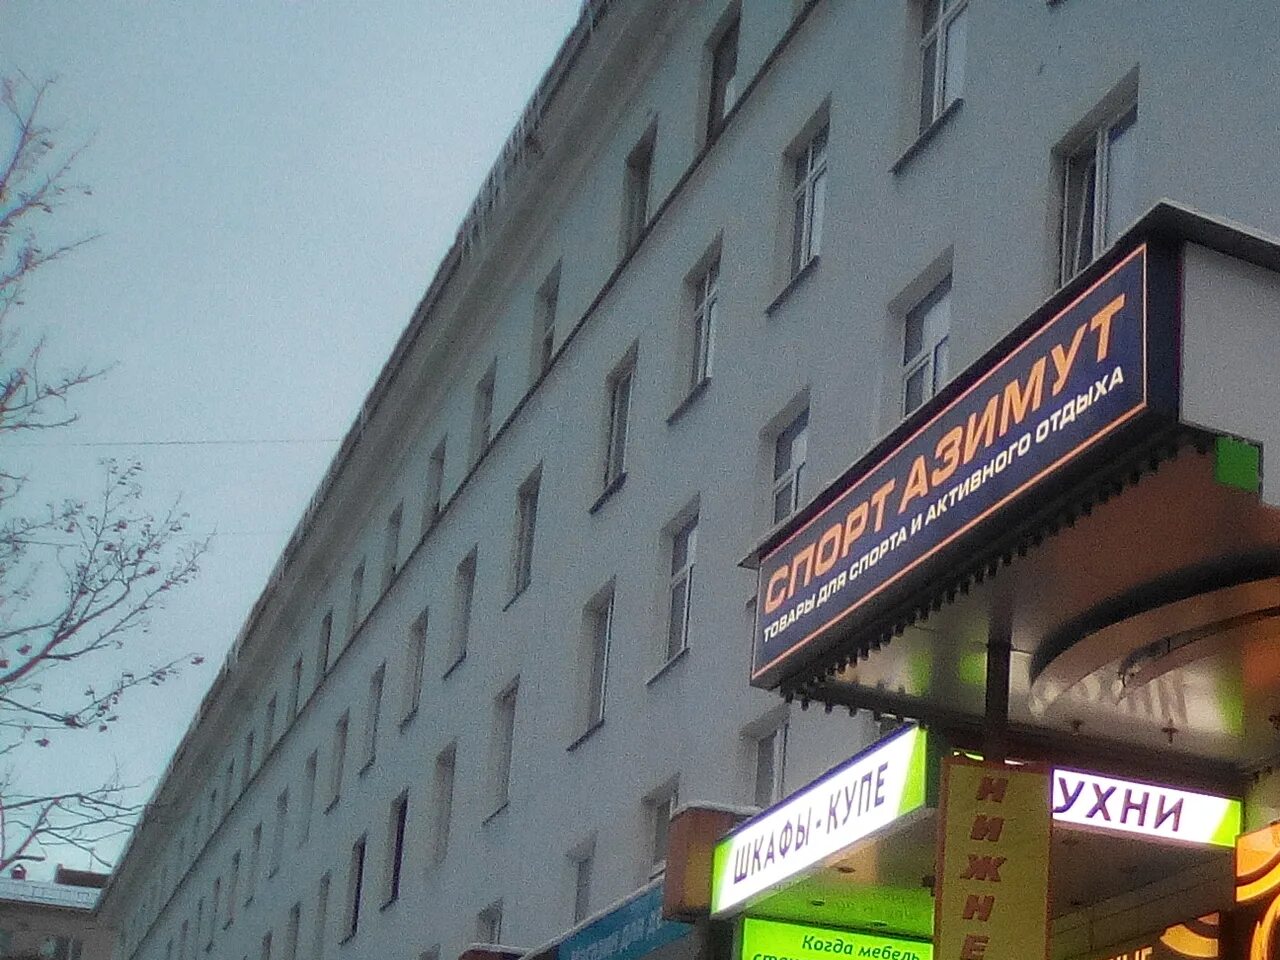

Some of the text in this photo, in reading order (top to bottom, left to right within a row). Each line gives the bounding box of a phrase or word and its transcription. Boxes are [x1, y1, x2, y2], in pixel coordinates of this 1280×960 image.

[763, 293, 1126, 614] СПОРТ АЗИМУТ
[763, 365, 1125, 643] ТОВАРЫ ДЛЯ СПОРТА И АКТИВНОГО ОТДЫХА
[802, 934, 853, 957] Когда
